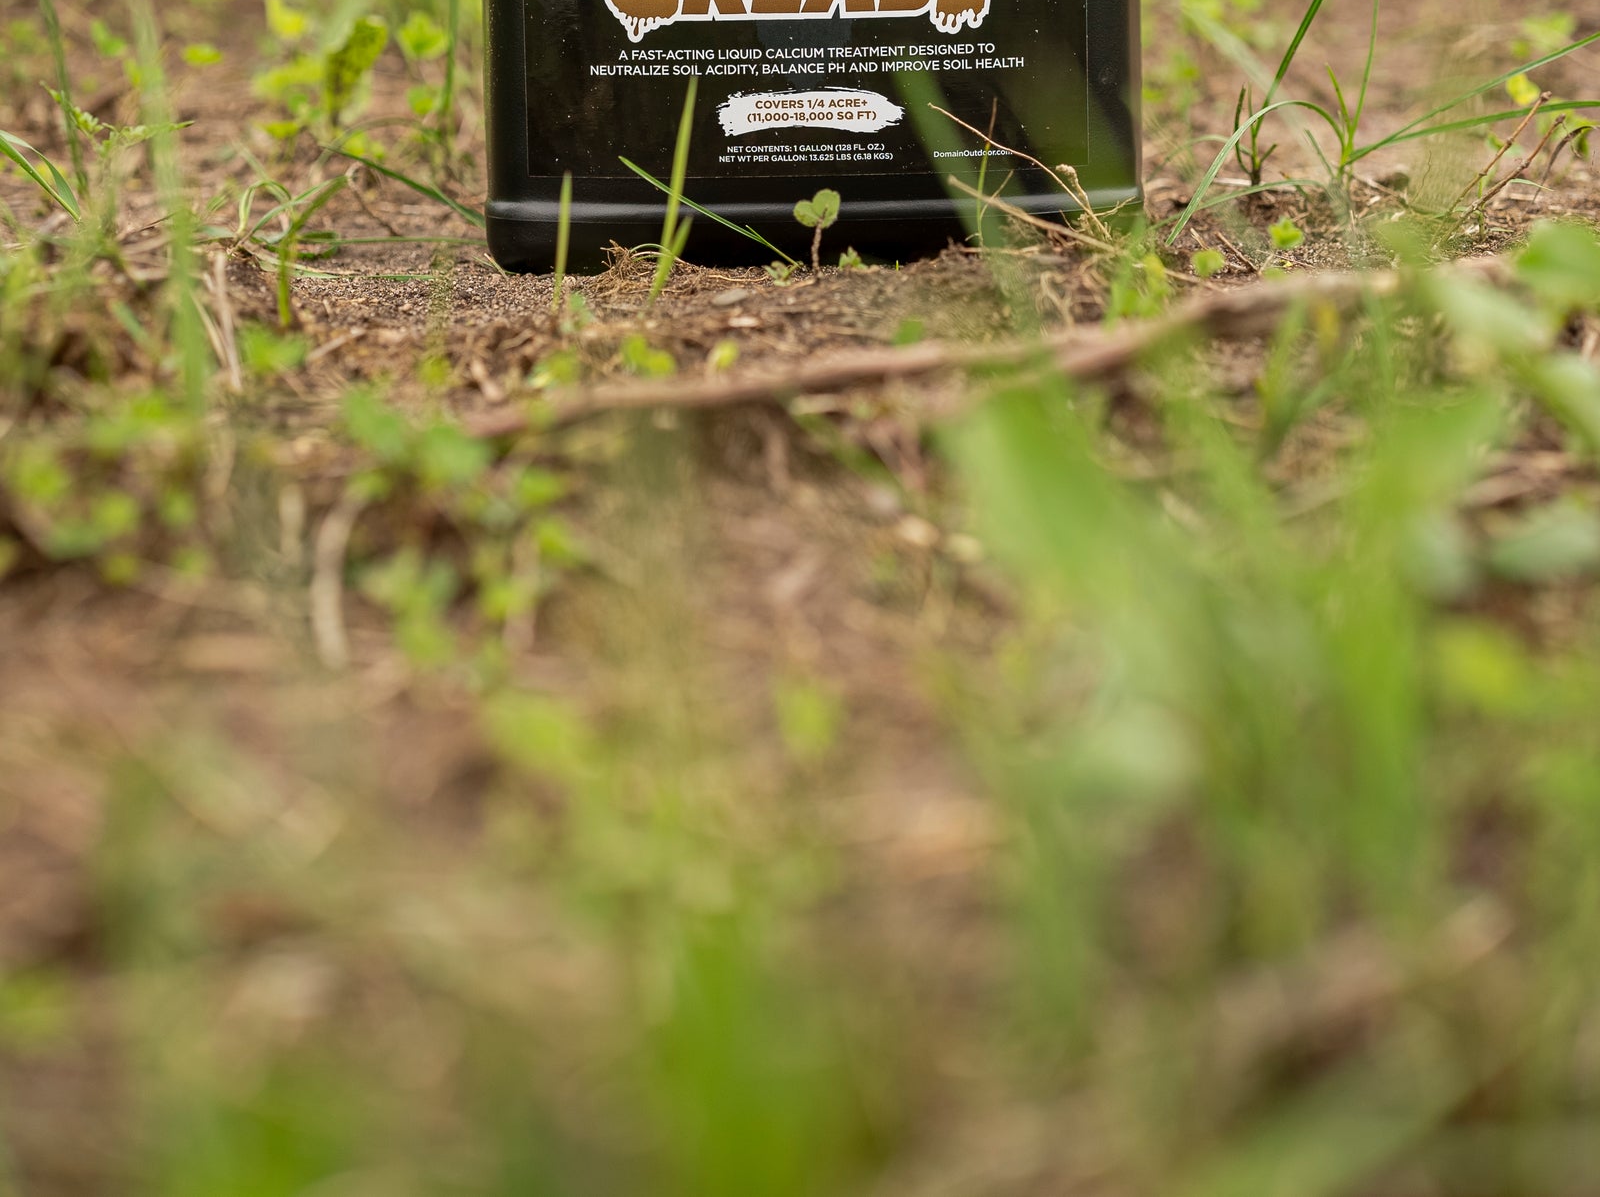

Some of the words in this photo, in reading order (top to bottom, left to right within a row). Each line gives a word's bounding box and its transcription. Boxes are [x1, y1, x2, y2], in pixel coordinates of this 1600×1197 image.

[619, 51, 628, 60] A
[632, 49, 715, 60] FAST-ACTING
[718, 49, 761, 61] LIQUID
[766, 48, 824, 59] CALCIUM
[827, 46, 905, 58] TREATMENT
[909, 44, 973, 56] DESIGNED
[977, 43, 995, 53] TO
[590, 65, 669, 76] NEUTRALIZE
[673, 64, 702, 75] SOIL
[705, 64, 758, 76] ACIDITY,
[763, 63, 825, 75] BALANCE
[829, 63, 845, 73] PH
[849, 62, 878, 72] AND
[882, 61, 940, 72] IMPROVE
[943, 59, 972, 70] SOIL
[976, 57, 1024, 68] HEALTH
[755, 100, 804, 109] COVERS
[807, 99, 824, 110] 1/4
[827, 99, 867, 108] ACRE+
[747, 112, 833, 123] (11,000-18,000
[837, 111, 853, 120] SQ
[857, 111, 877, 120] FT)
[745, 145, 792, 153] CONTENTS:
[799, 144, 833, 152] GALLON
[835, 144, 851, 152] (128
[719, 155, 735, 163] NET
[771, 154, 808, 162] GALLON:
[836, 153, 851, 161] LBS
[853, 153, 872, 161] (6.18
[874, 152, 893, 160] KGS)
